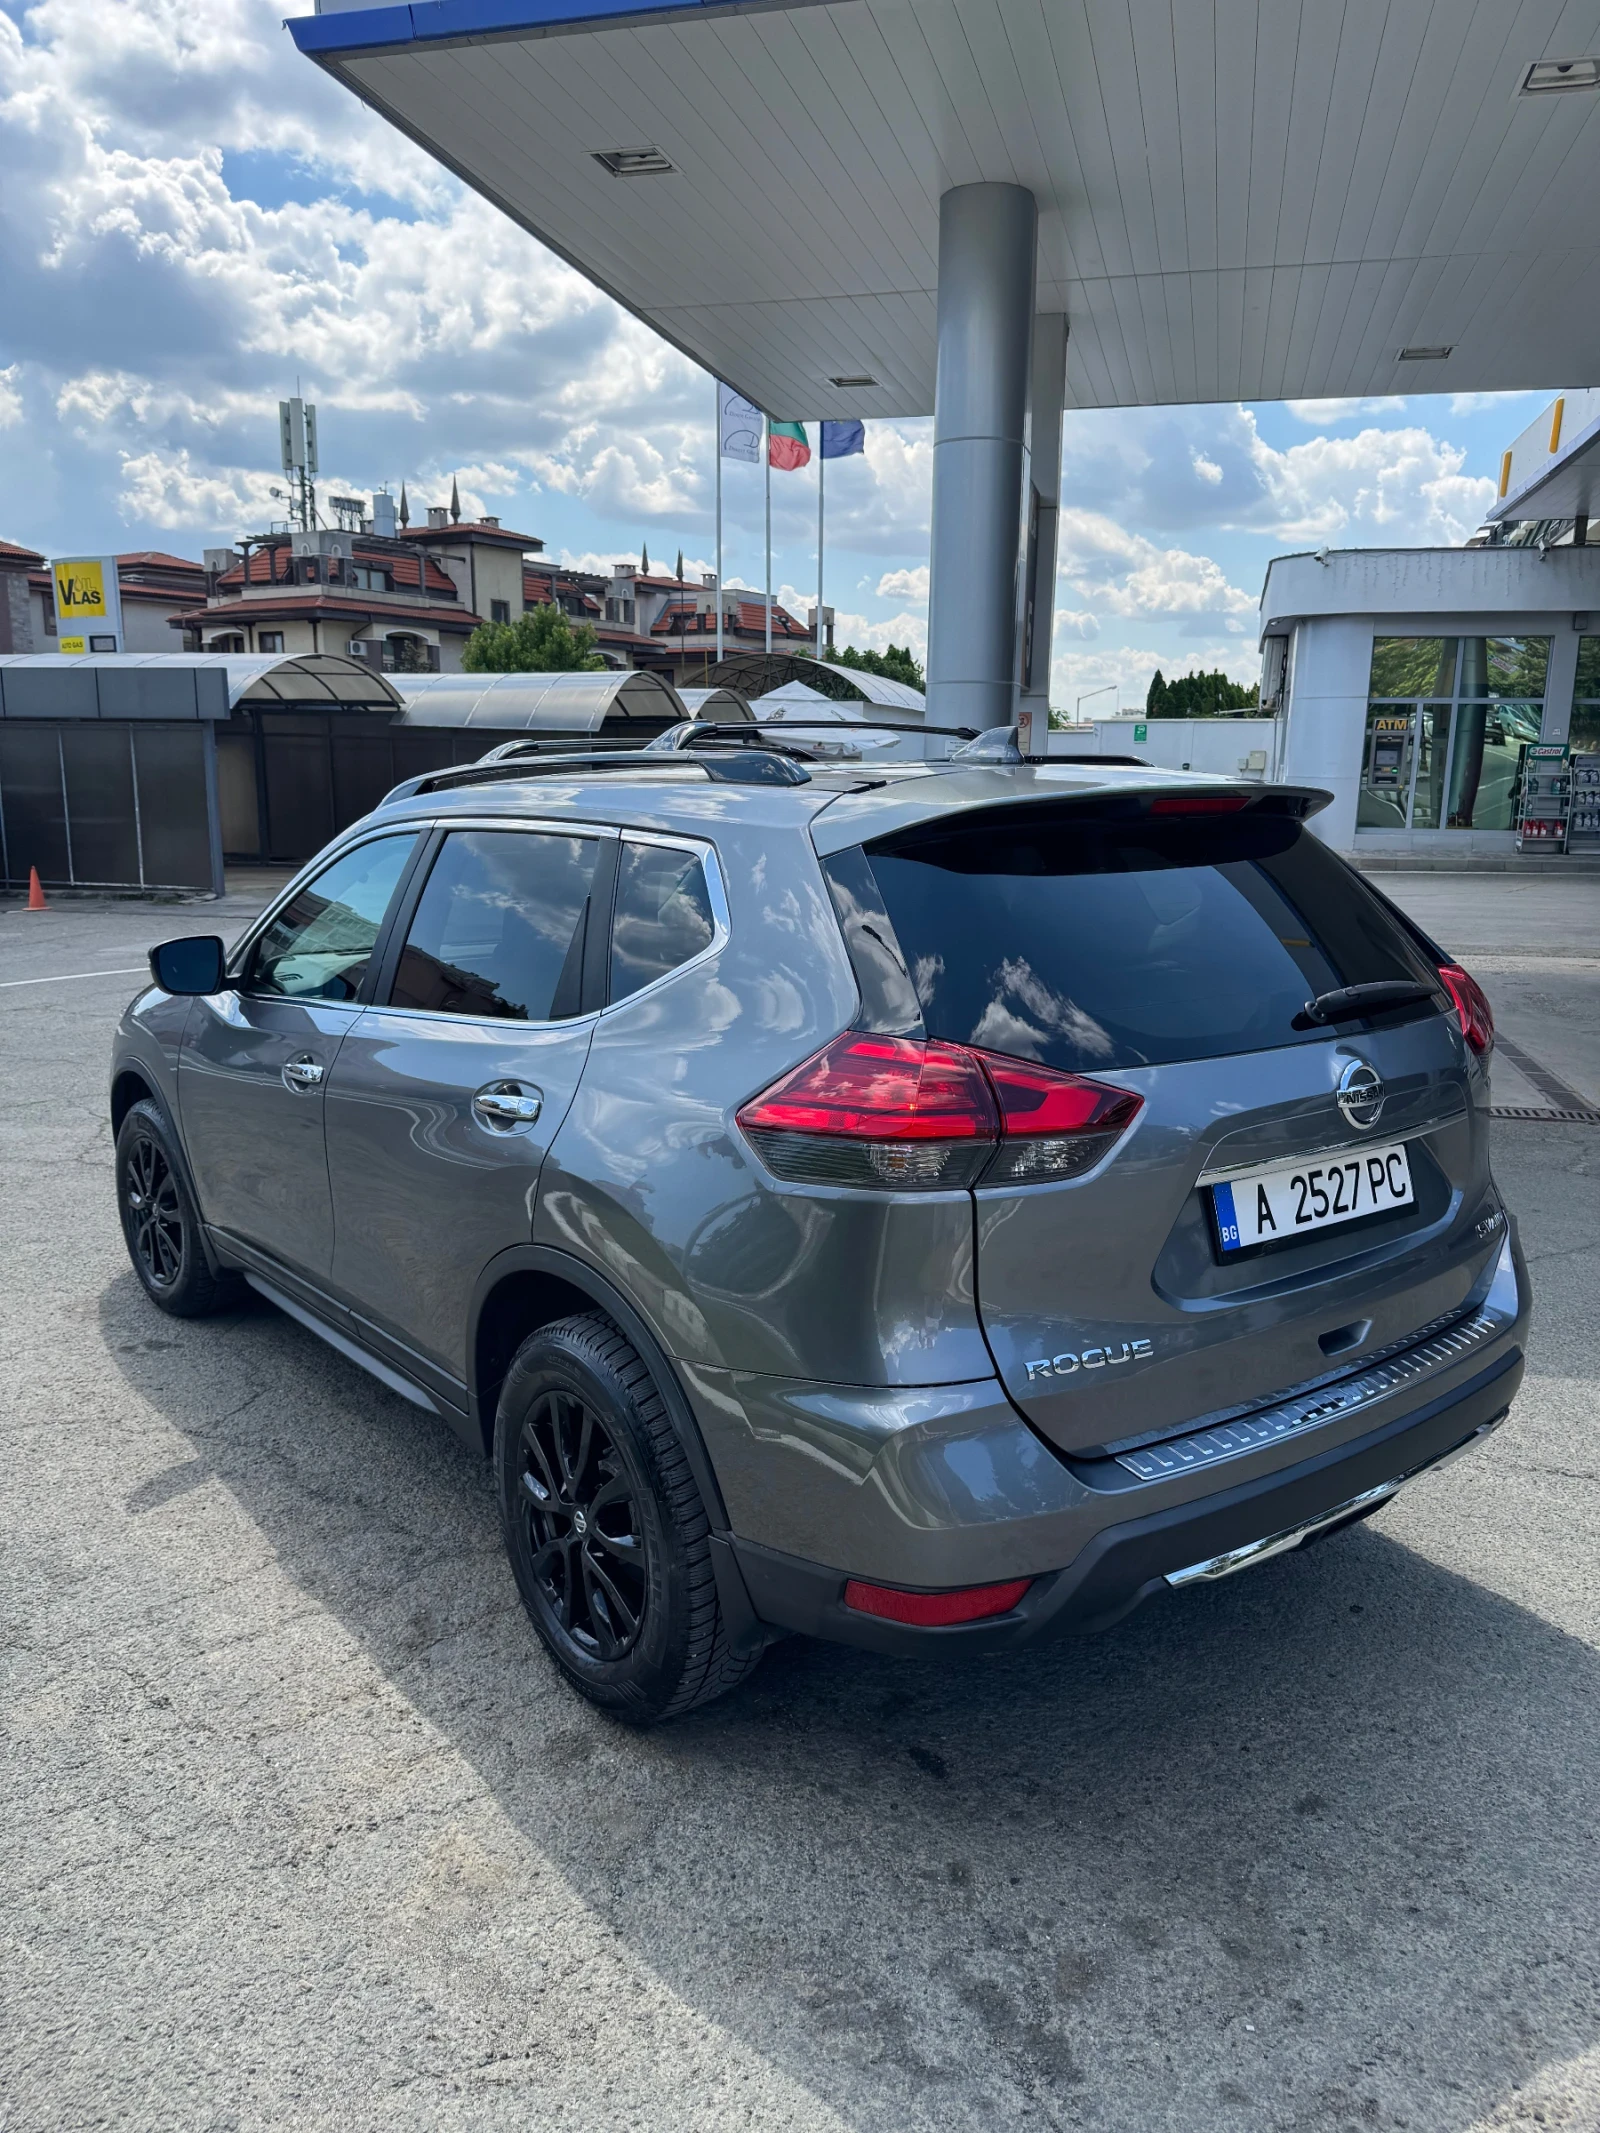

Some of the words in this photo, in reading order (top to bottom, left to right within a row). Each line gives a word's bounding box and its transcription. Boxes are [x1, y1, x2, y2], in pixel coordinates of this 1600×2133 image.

[59, 579, 101, 605] VLAS
[1376, 720, 1408, 730] ATM
[1538, 747, 1563, 755] Castrol
[1257, 1183, 1277, 1234] A
[1290, 1162, 1361, 1224] 2527
[1366, 1153, 1406, 1204] PC
[1222, 1225, 1238, 1242] BG
[1023, 1338, 1154, 1381] ROGUE
